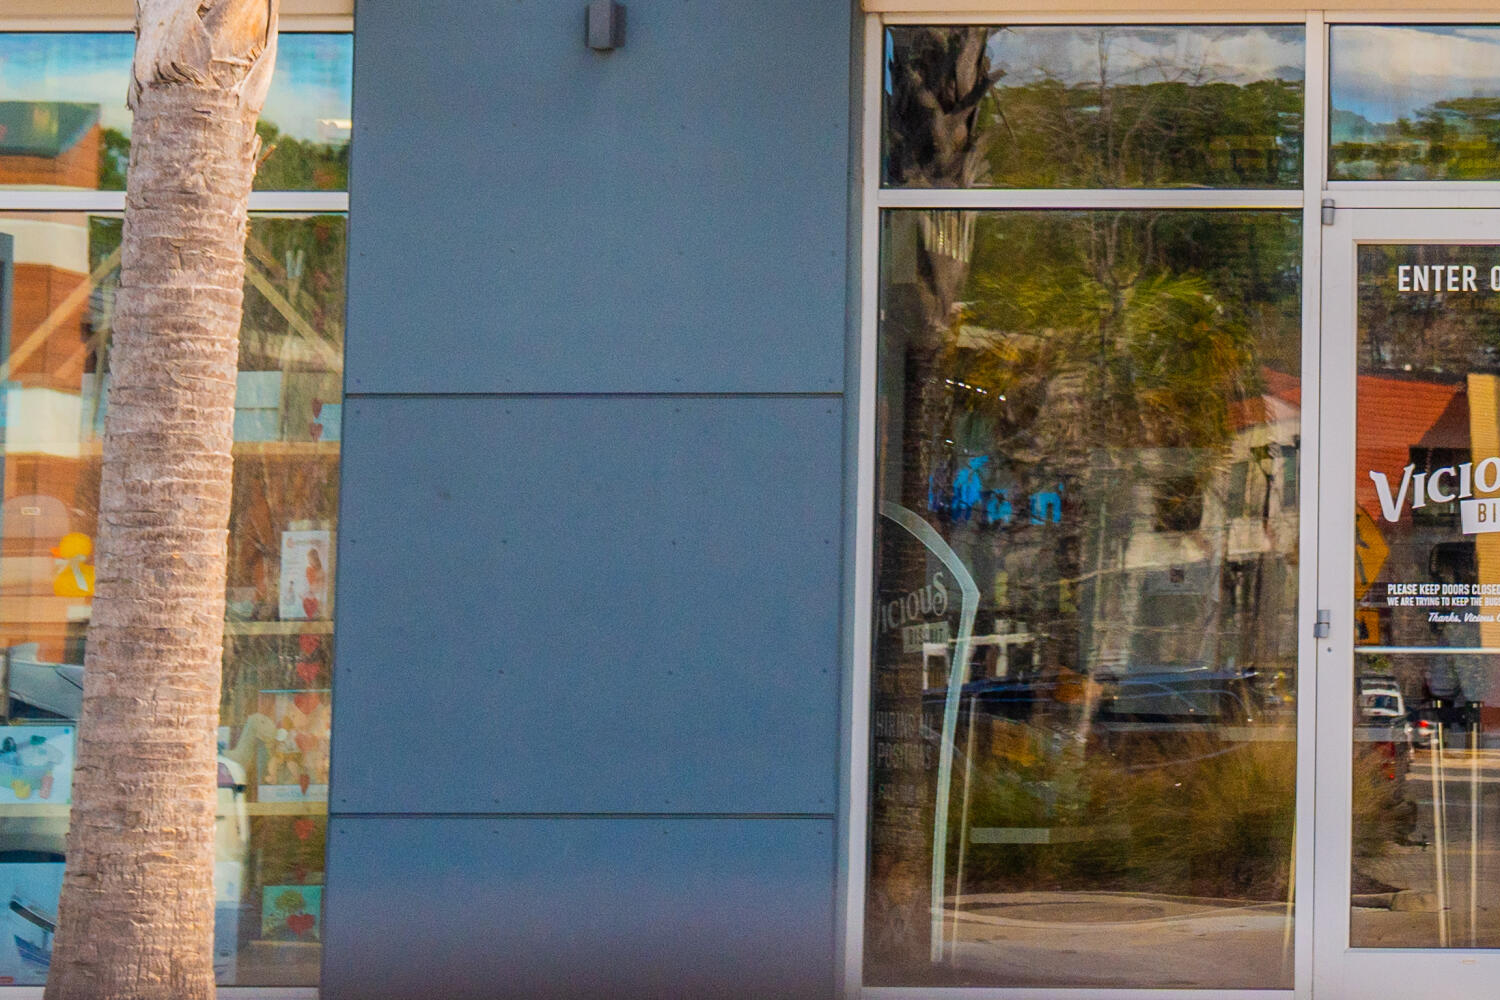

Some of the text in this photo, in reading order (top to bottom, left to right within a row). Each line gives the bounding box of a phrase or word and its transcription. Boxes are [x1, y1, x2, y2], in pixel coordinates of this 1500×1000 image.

[1397, 264, 1478, 292] ENTER
[1387, 583, 1418, 596] PLEASE
[1419, 583, 1441, 596] KEEP
[1442, 583, 1470, 596] DOORS
[1386, 596, 1399, 607] WE
[1400, 596, 1415, 607] ARE
[1415, 596, 1441, 607] TRYING
[1441, 596, 1450, 607] TO
[1451, 596, 1470, 607] KEEP
[1470, 596, 1483, 607] THE
[1463, 612, 1495, 623] Vicious
